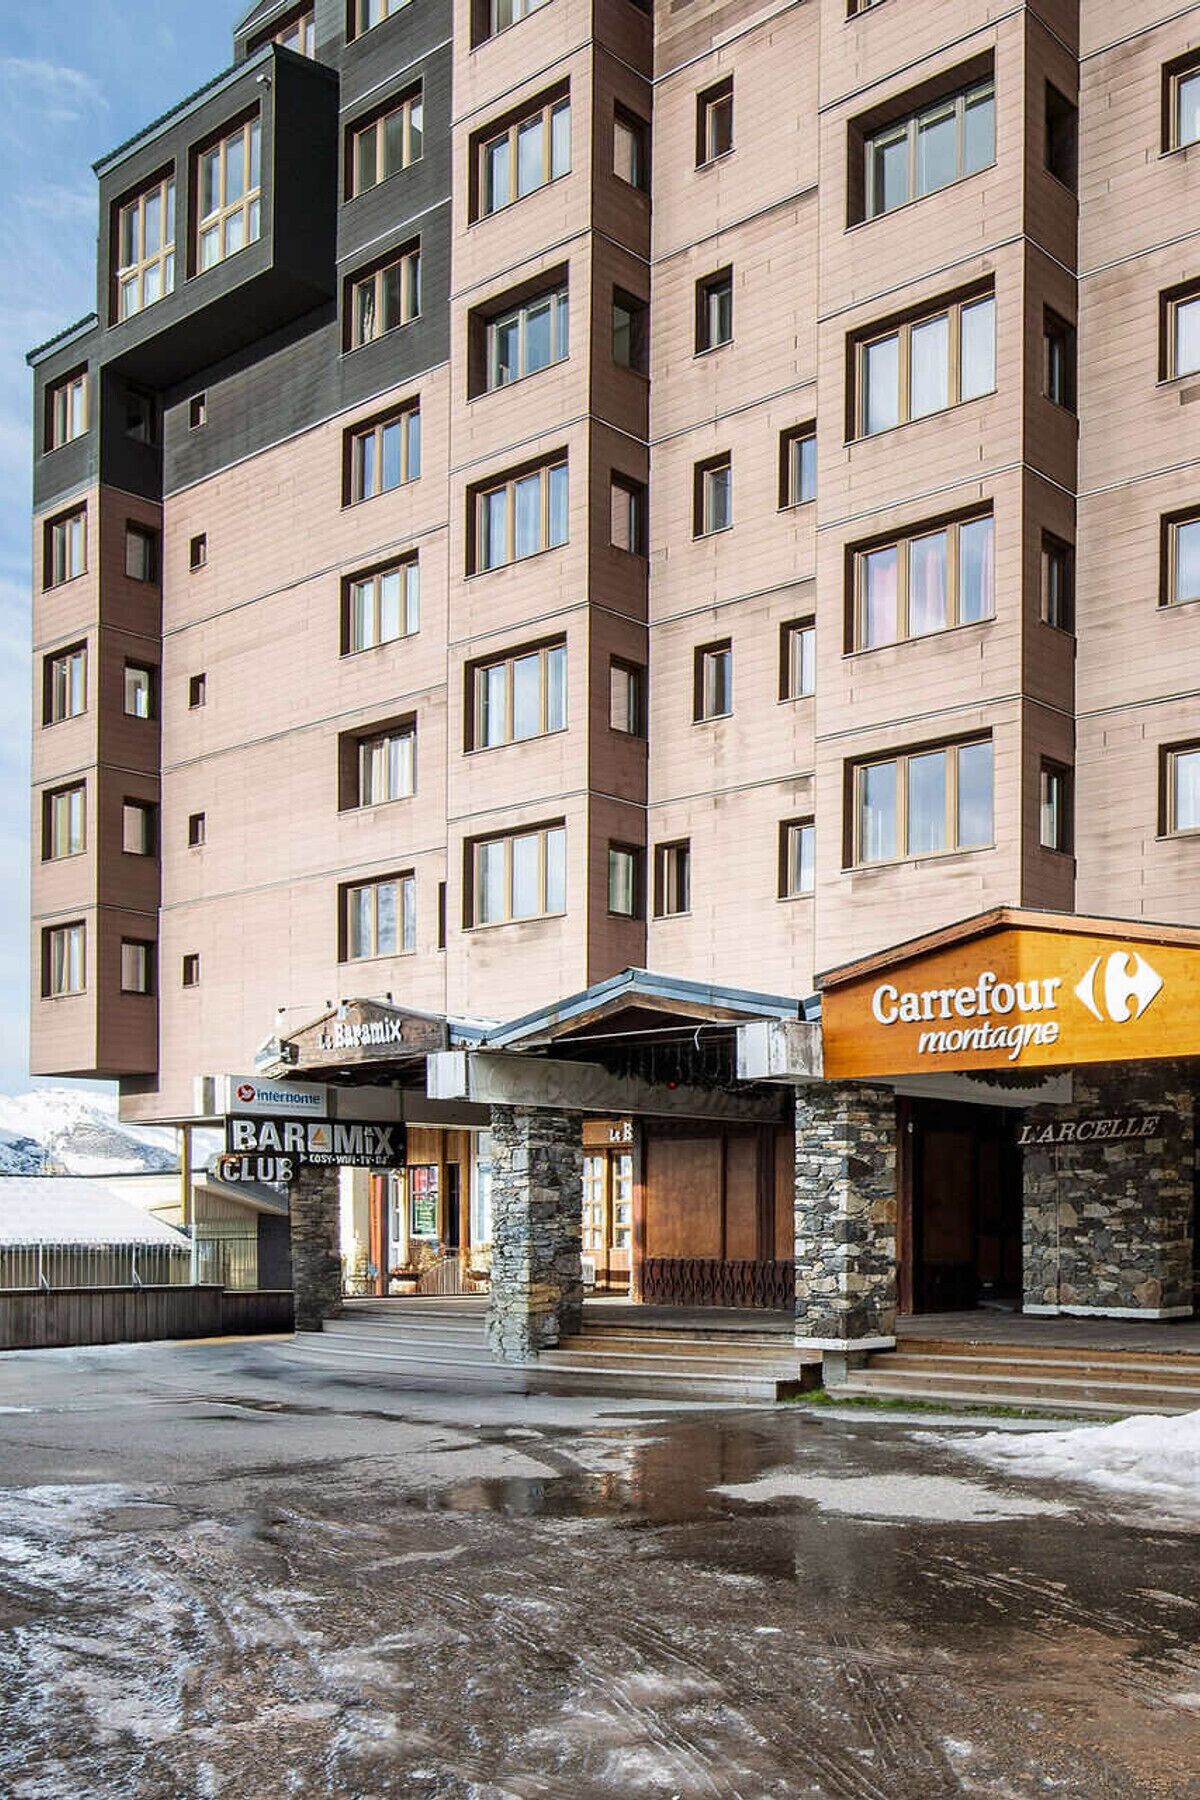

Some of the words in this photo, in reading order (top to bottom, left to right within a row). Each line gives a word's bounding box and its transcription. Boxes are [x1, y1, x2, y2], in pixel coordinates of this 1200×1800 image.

[872, 971, 1063, 1025] Carrefour
[333, 1017, 402, 1049] Baramix
[918, 1020, 1060, 1061] montagne
[1017, 1115, 1161, 1146] L'ARCELLE
[222, 1156, 294, 1182] CLUB
